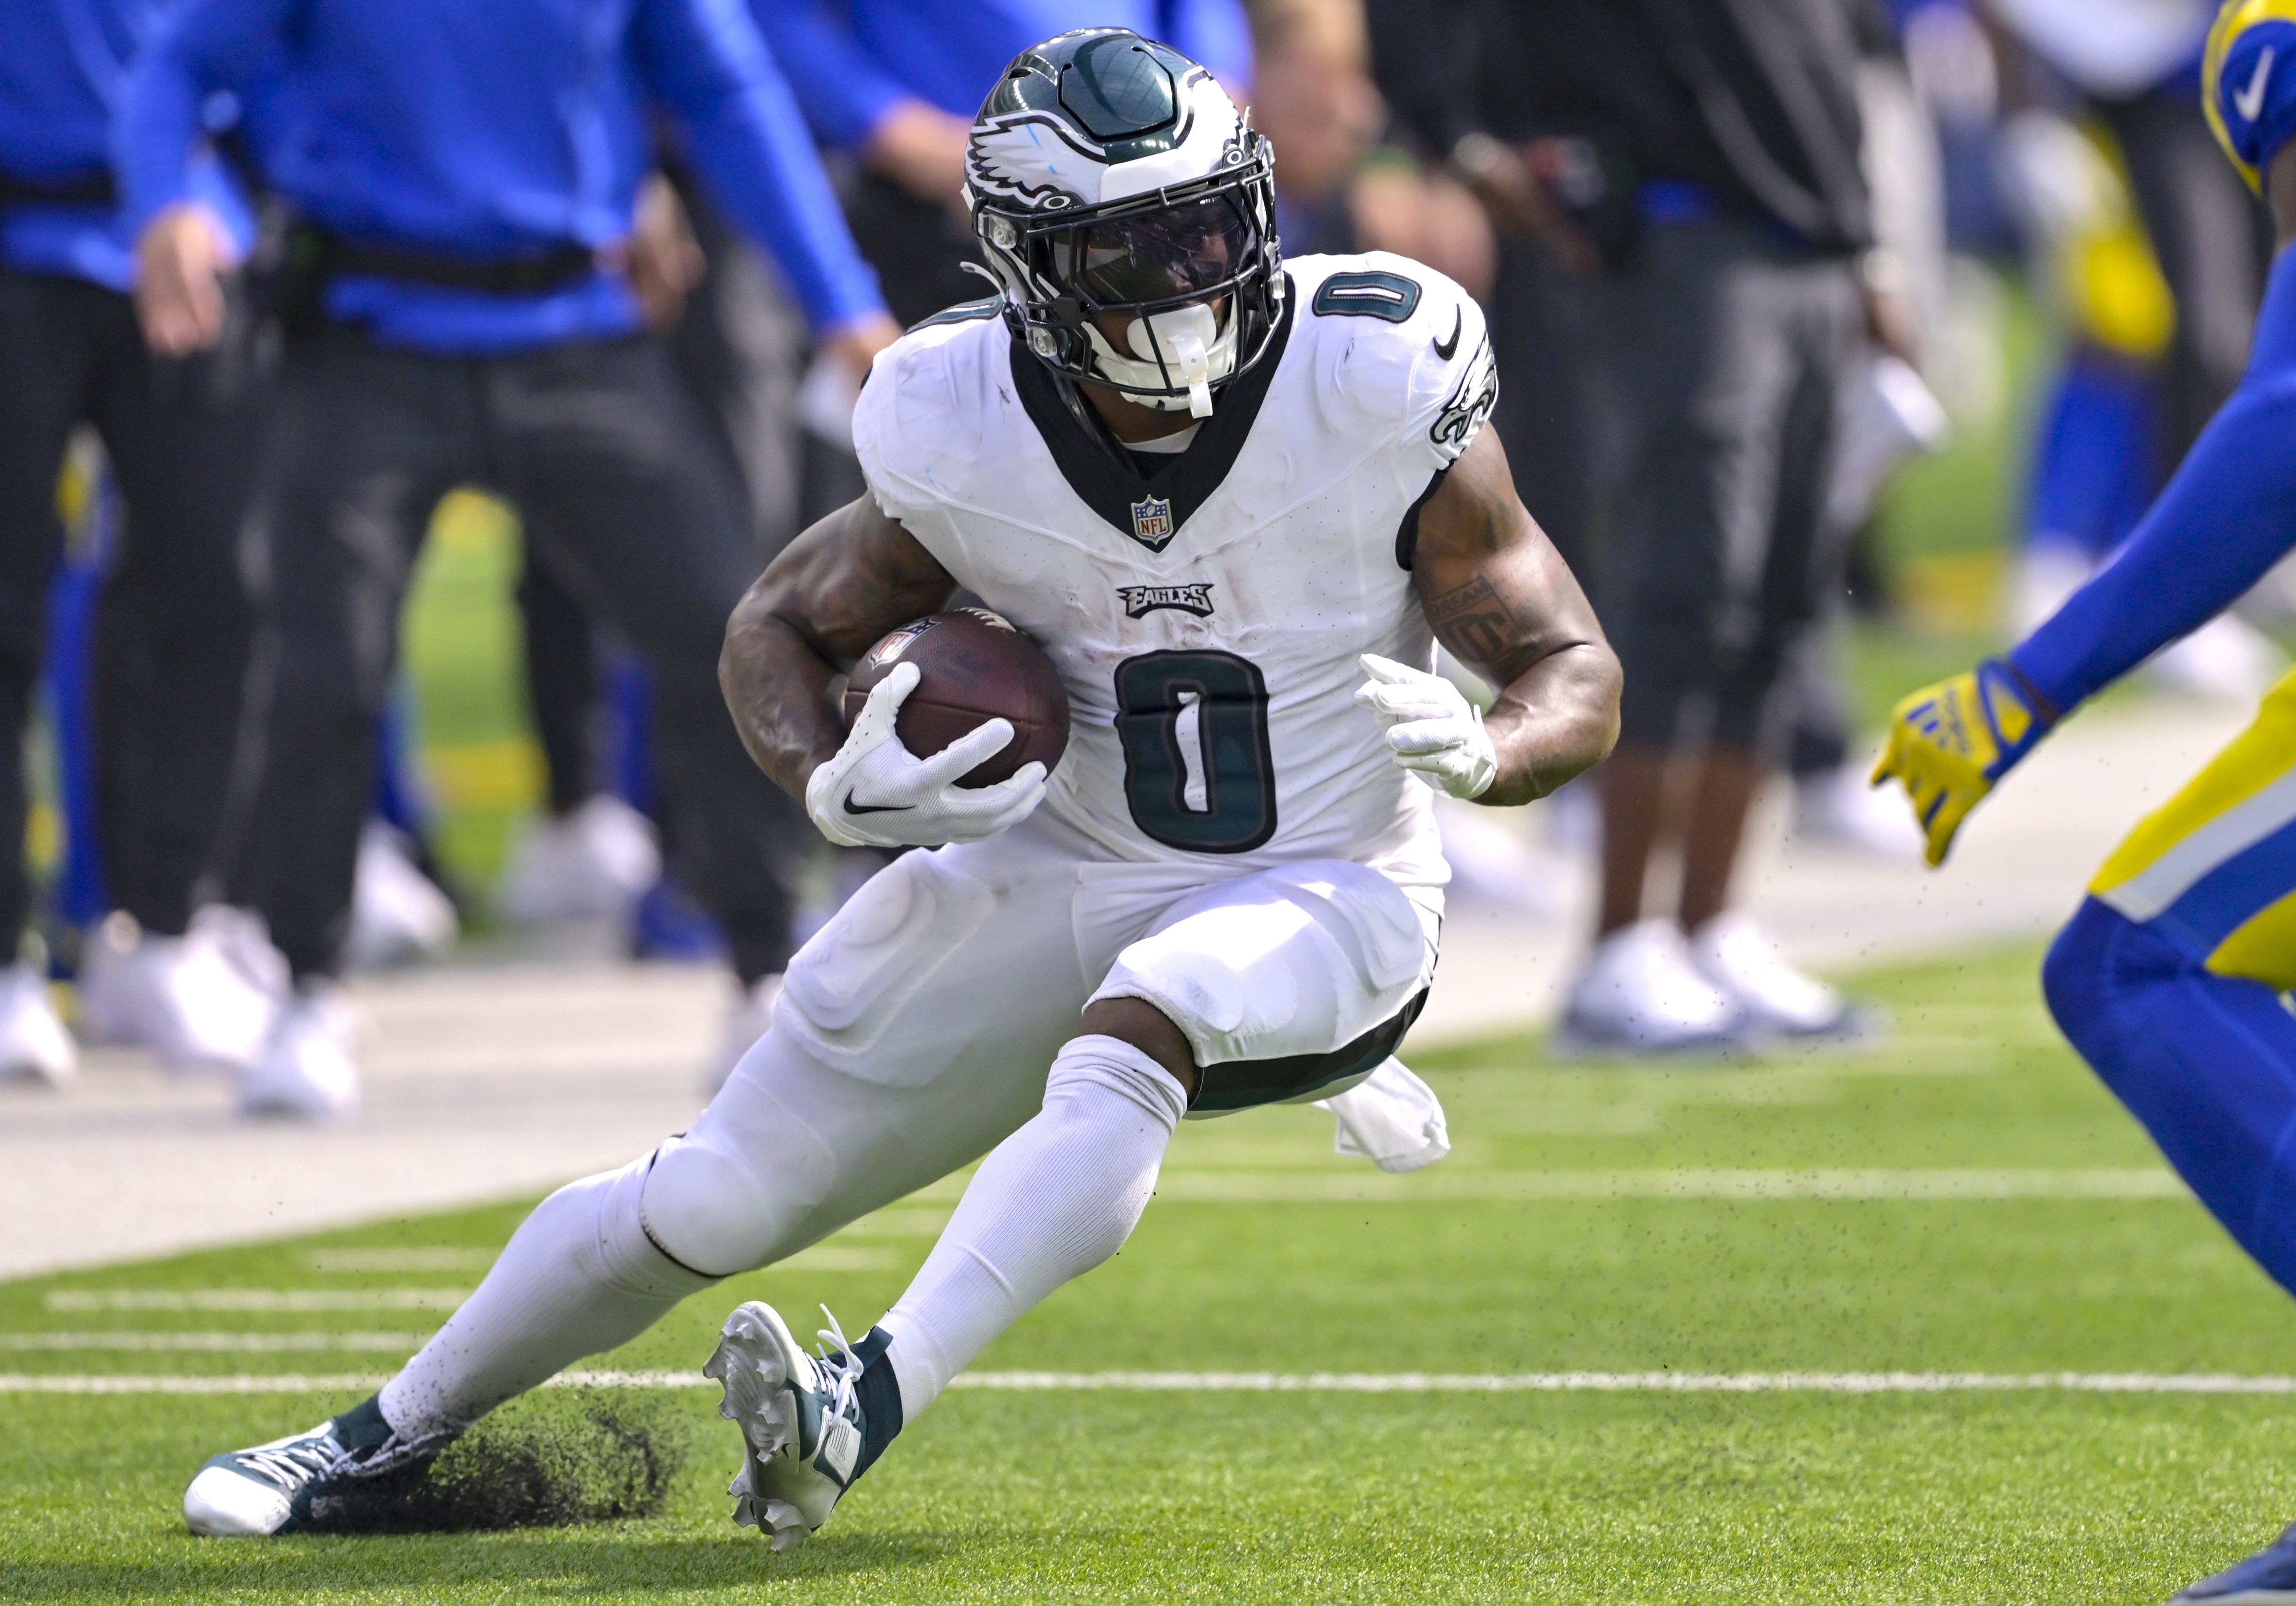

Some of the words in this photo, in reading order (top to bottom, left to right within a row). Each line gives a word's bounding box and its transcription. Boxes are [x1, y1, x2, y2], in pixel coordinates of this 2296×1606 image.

[1312, 271, 1422, 324] 0
[1140, 518, 1166, 535] NFL
[1117, 584, 1214, 619] EAGLES
[874, 633, 910, 659] NFL
[1113, 649, 1277, 854] 0
